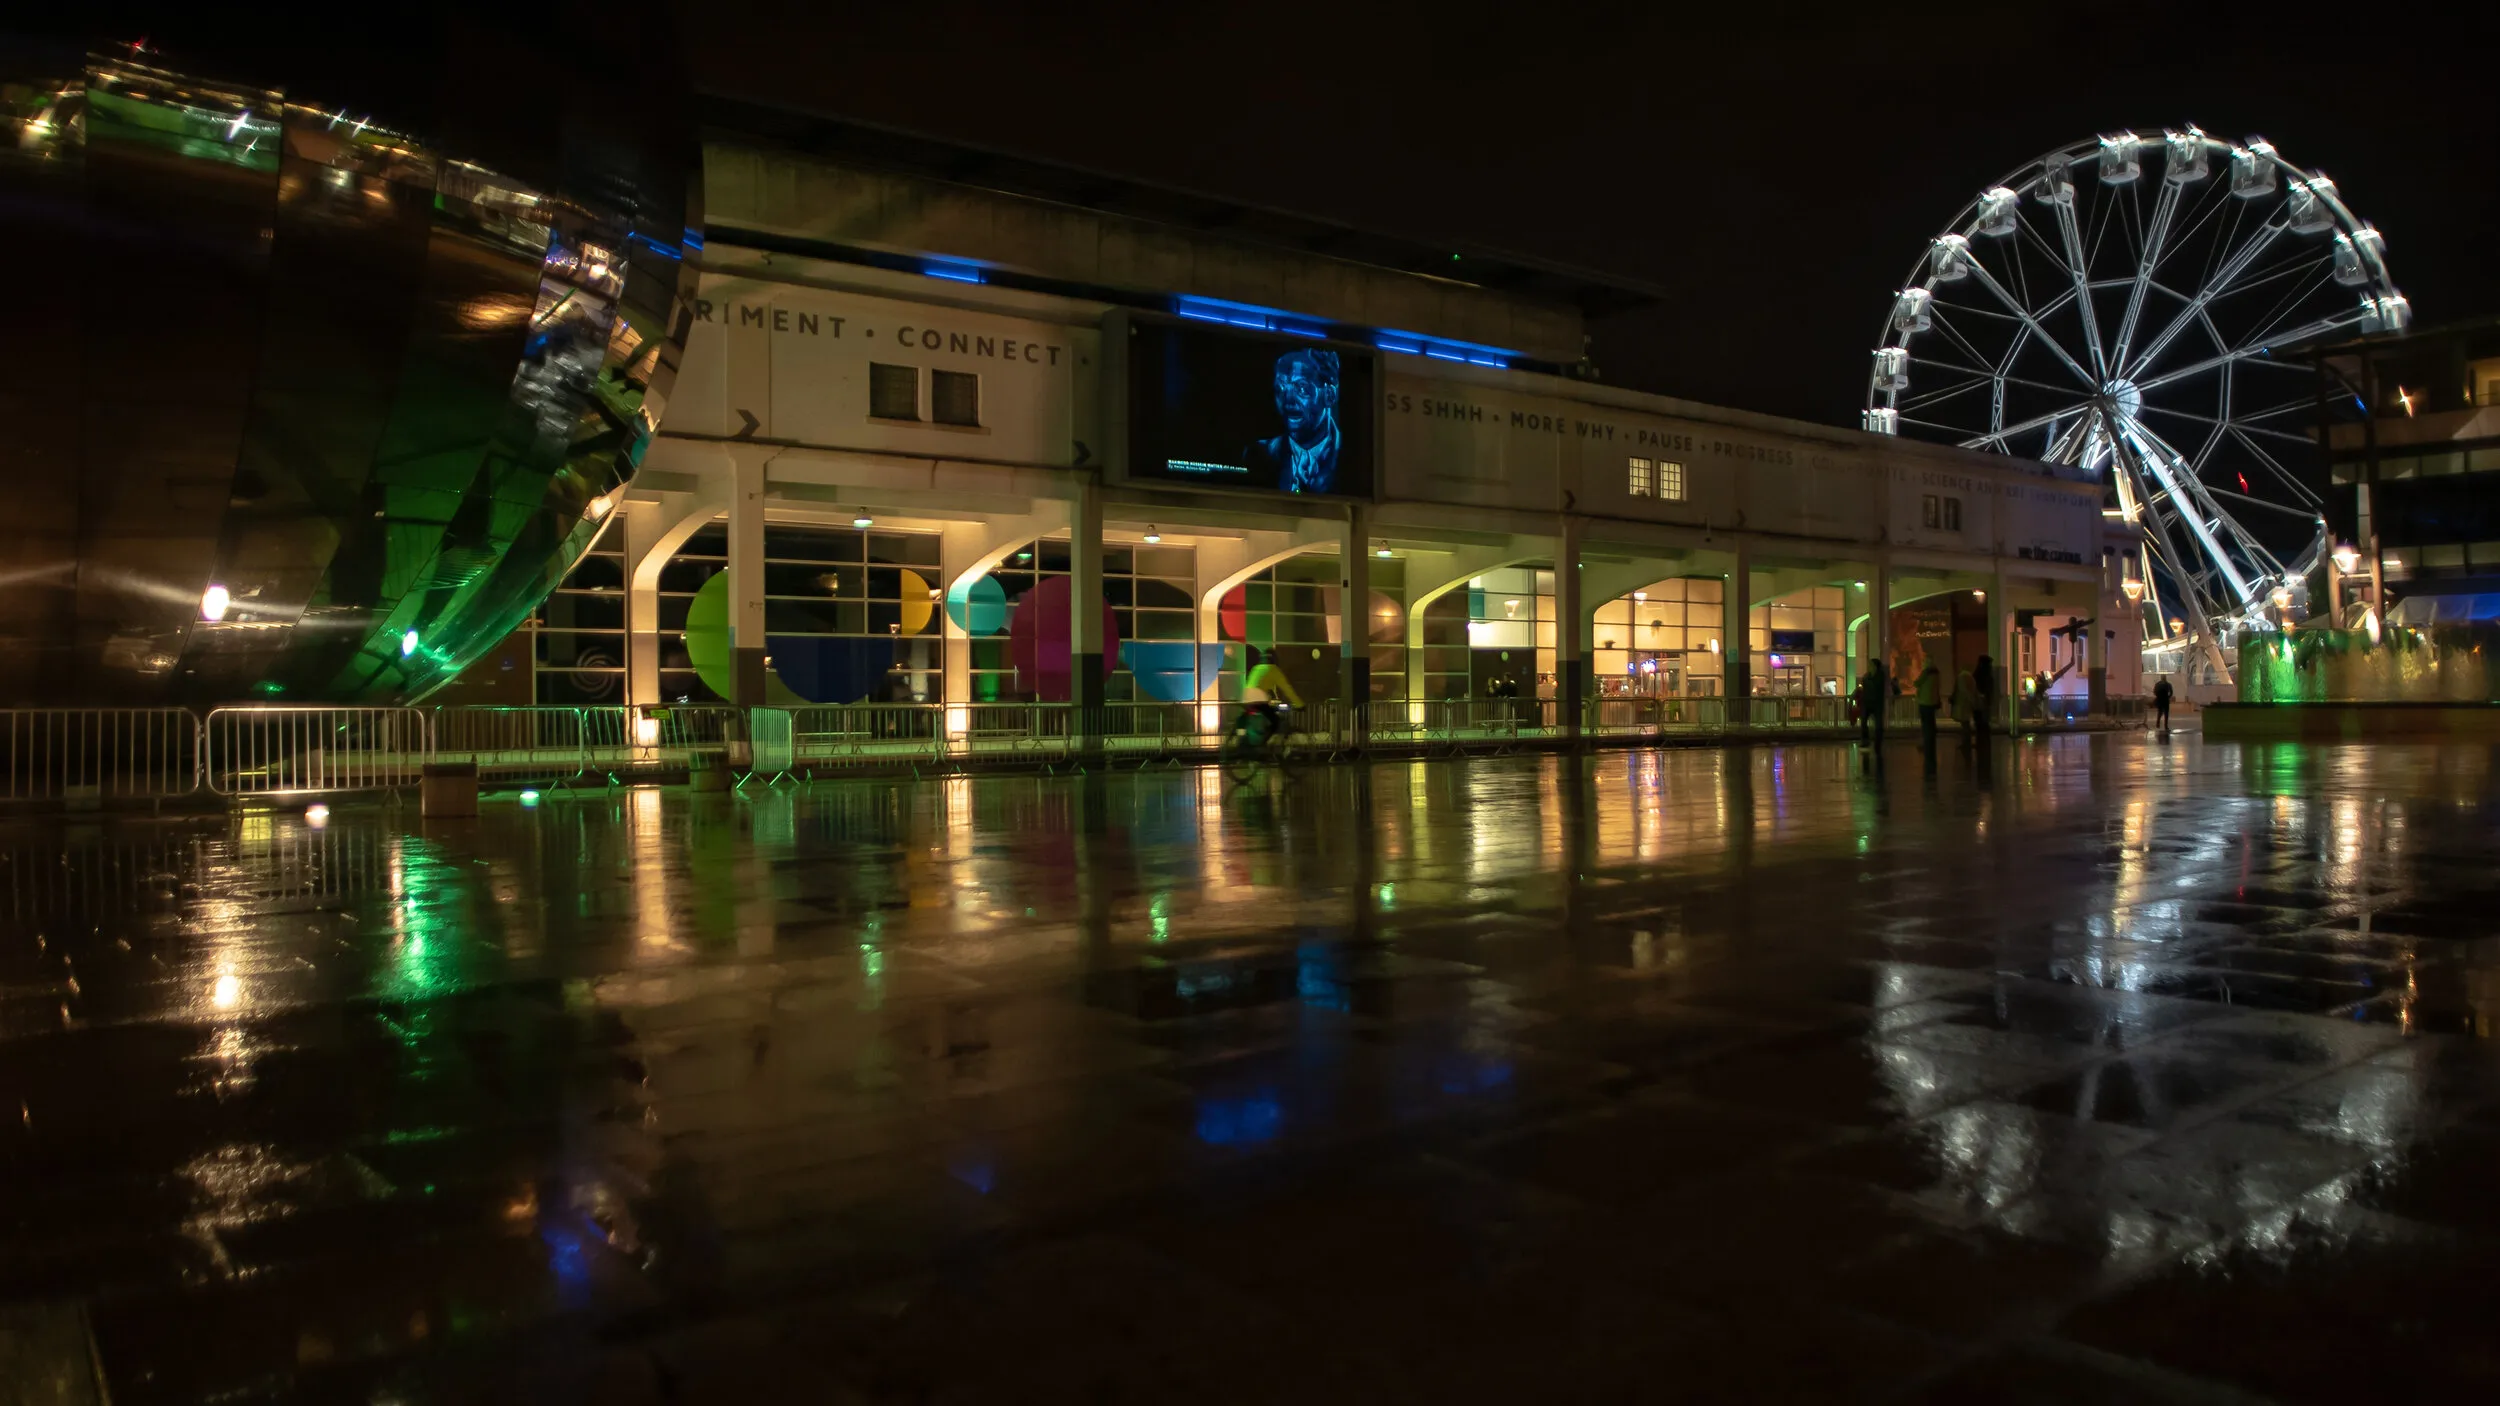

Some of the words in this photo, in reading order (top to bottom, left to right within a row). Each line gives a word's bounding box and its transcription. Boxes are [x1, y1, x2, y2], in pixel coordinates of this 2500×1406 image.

[898, 325, 1062, 366] CONNECT
[1422, 398, 1482, 423] SHHH
[1510, 411, 1566, 435] MORE
[1575, 420, 1615, 441] WHY
[1639, 430, 1692, 451] PAUSE
[1714, 442, 1793, 466] PROGRESS
[1921, 473, 1972, 492] SCIENCE
